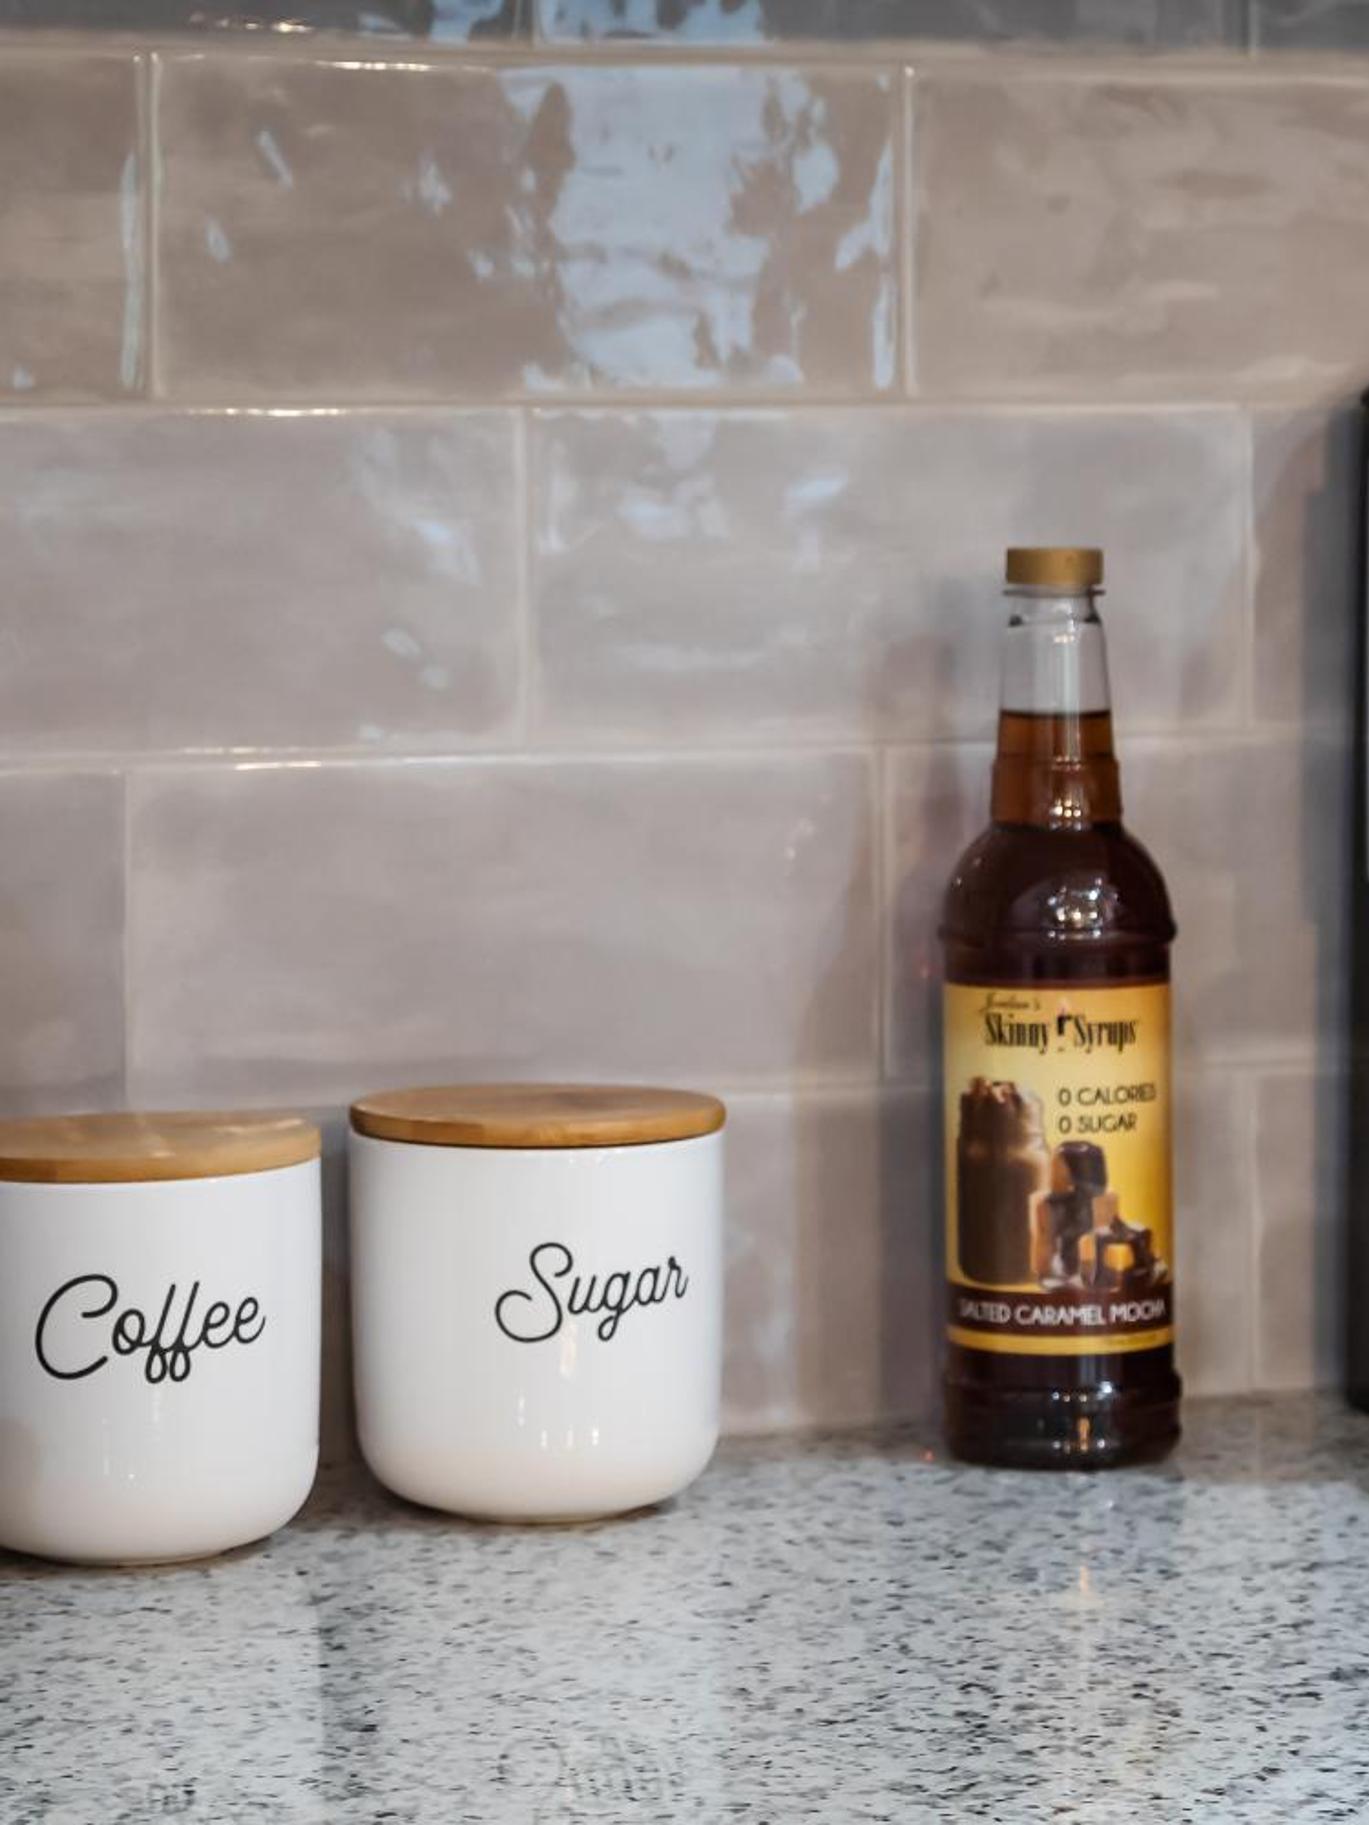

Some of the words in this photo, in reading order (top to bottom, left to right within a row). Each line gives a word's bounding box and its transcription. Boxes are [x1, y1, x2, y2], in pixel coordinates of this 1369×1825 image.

[984, 1012, 1049, 1054] Skinny
[1073, 1013, 1138, 1054] Syrups
[1058, 1087, 1072, 1107] 0
[1058, 1115, 1072, 1135] 0
[1077, 1111, 1138, 1134] SUGAR
[495, 1242, 689, 1342] Sugar
[35, 1273, 266, 1384] Coffee
[1013, 1303, 1107, 1326] CARAMEL
